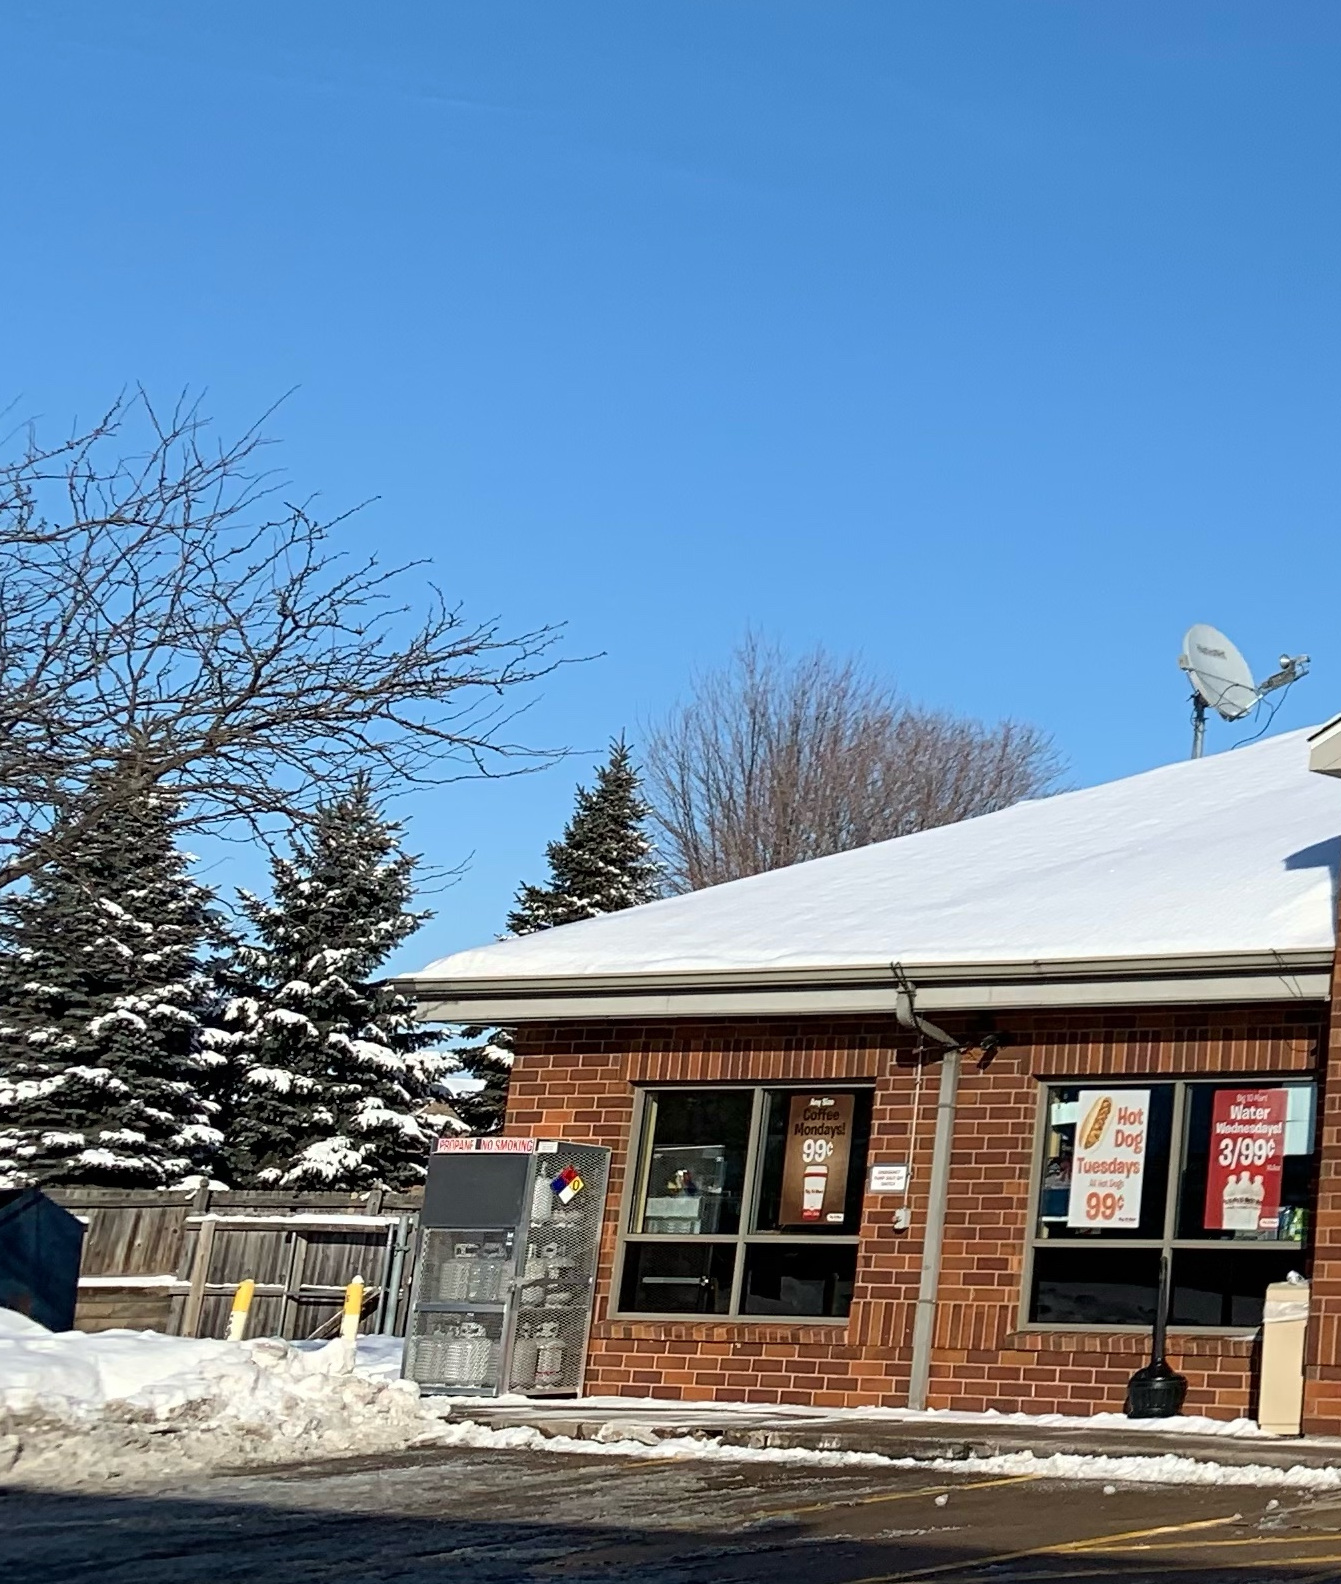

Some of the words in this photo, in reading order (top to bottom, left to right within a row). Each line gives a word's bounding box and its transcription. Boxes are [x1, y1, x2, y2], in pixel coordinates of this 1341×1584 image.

[809, 1097, 821, 1107] Any
[803, 1107, 839, 1121] Coffee
[1117, 1106, 1144, 1126] Hot
[1230, 1105, 1272, 1120] Water
[794, 1122, 846, 1138] Mondays!
[1216, 1121, 1283, 1136] Wednesdays!
[439, 1138, 475, 1151] PROPANE
[480, 1139, 494, 1151] NO
[495, 1139, 534, 1151] SMOKING
[1114, 1129, 1144, 1154] Dog
[802, 1139, 834, 1163] 99¢
[1218, 1137, 1276, 1170] 3/99¢
[1077, 1157, 1140, 1179] Tuesdays
[1086, 1191, 1125, 1221] 99¢
